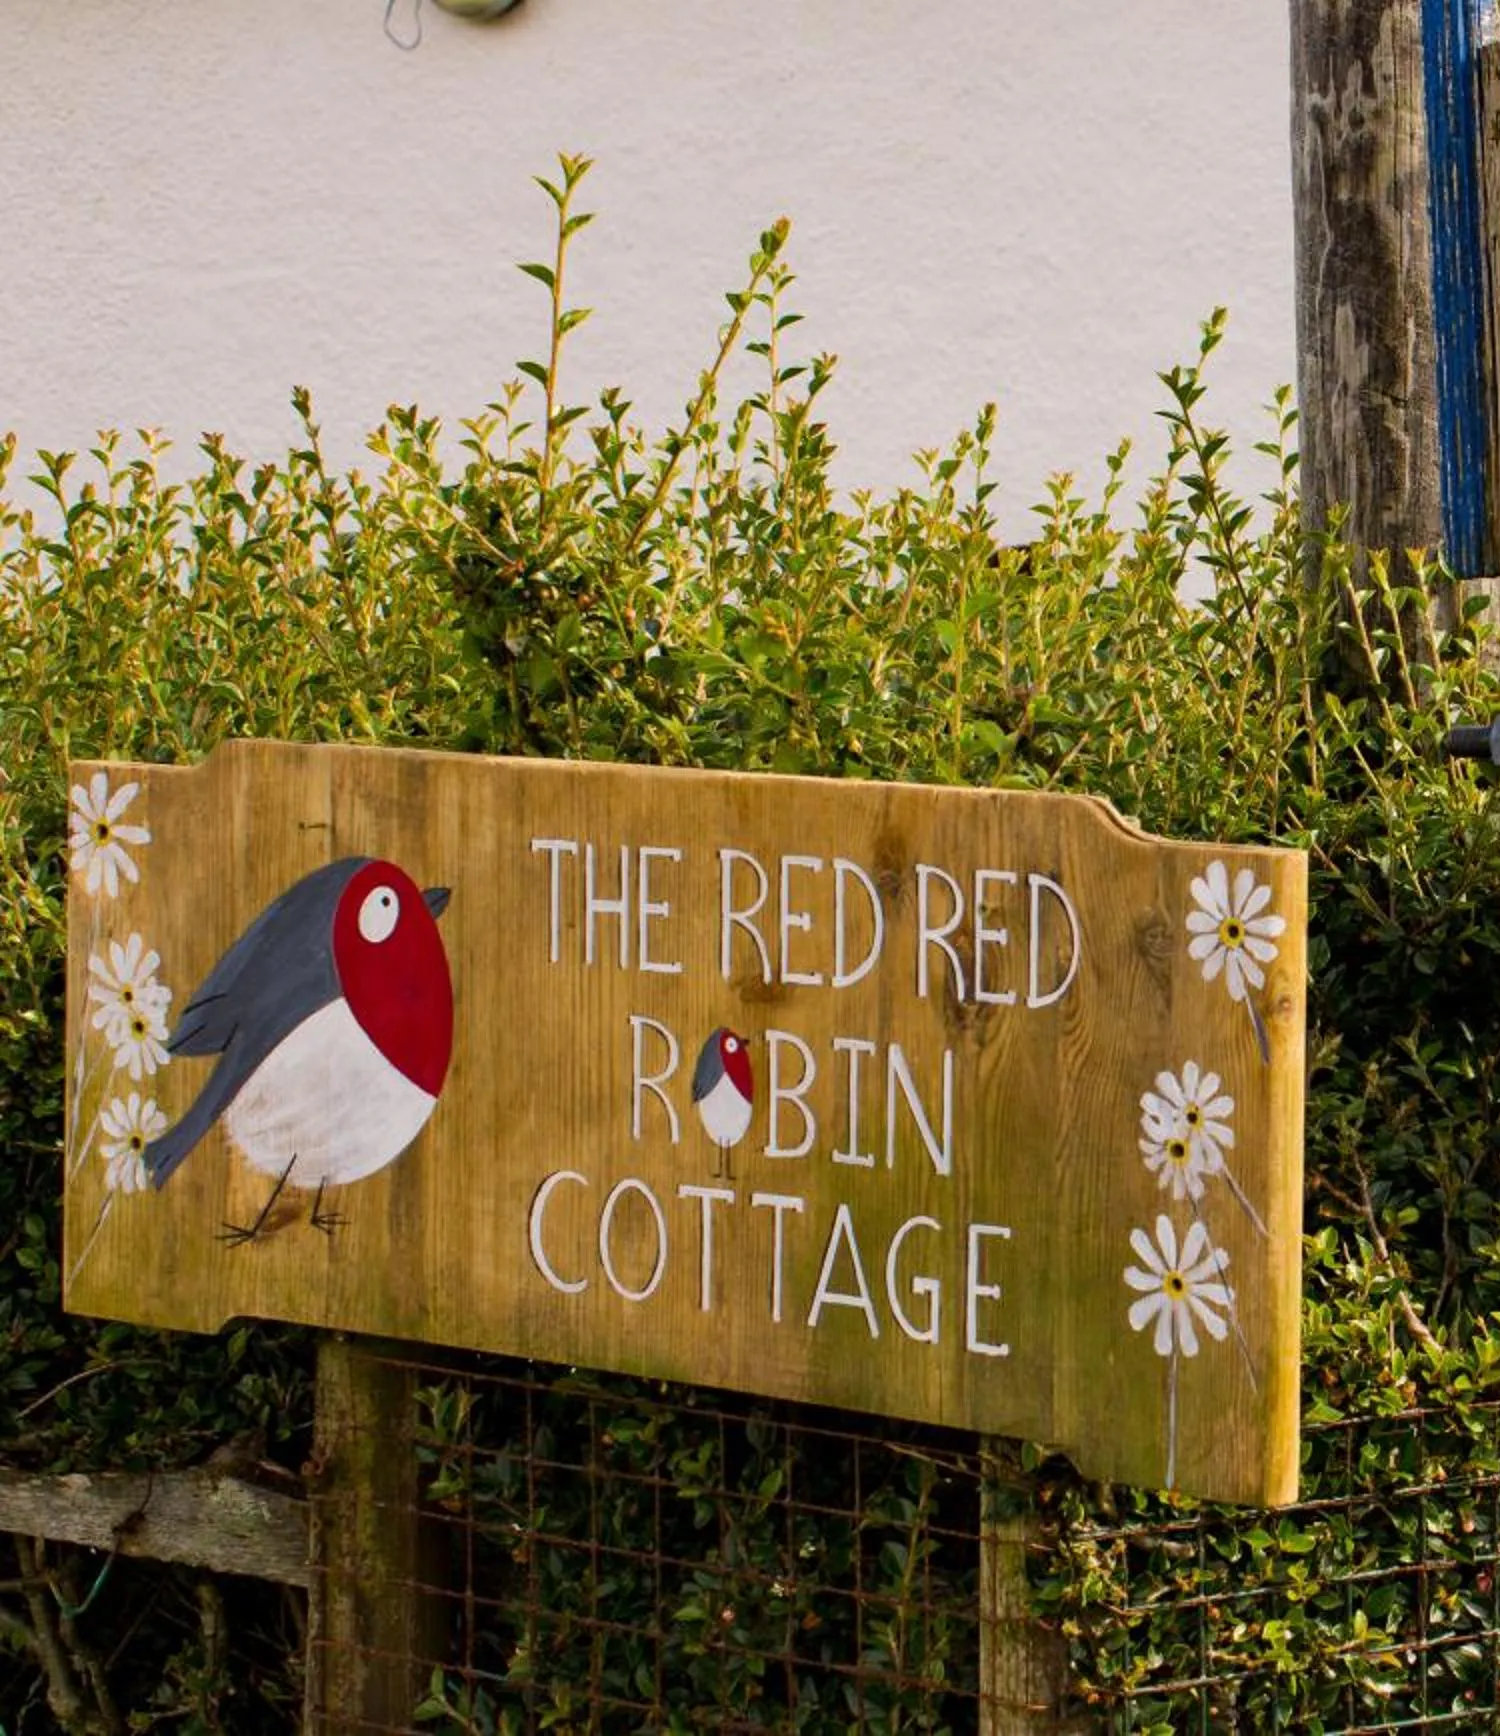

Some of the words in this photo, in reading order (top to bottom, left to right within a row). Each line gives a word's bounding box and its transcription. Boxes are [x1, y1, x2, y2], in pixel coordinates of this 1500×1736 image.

[531, 839, 682, 973] THE
[719, 849, 884, 988] RED
[915, 864, 1082, 1008] RED
[630, 1015, 953, 1176] RBIN
[529, 1171, 1012, 1356] COTTAGE
